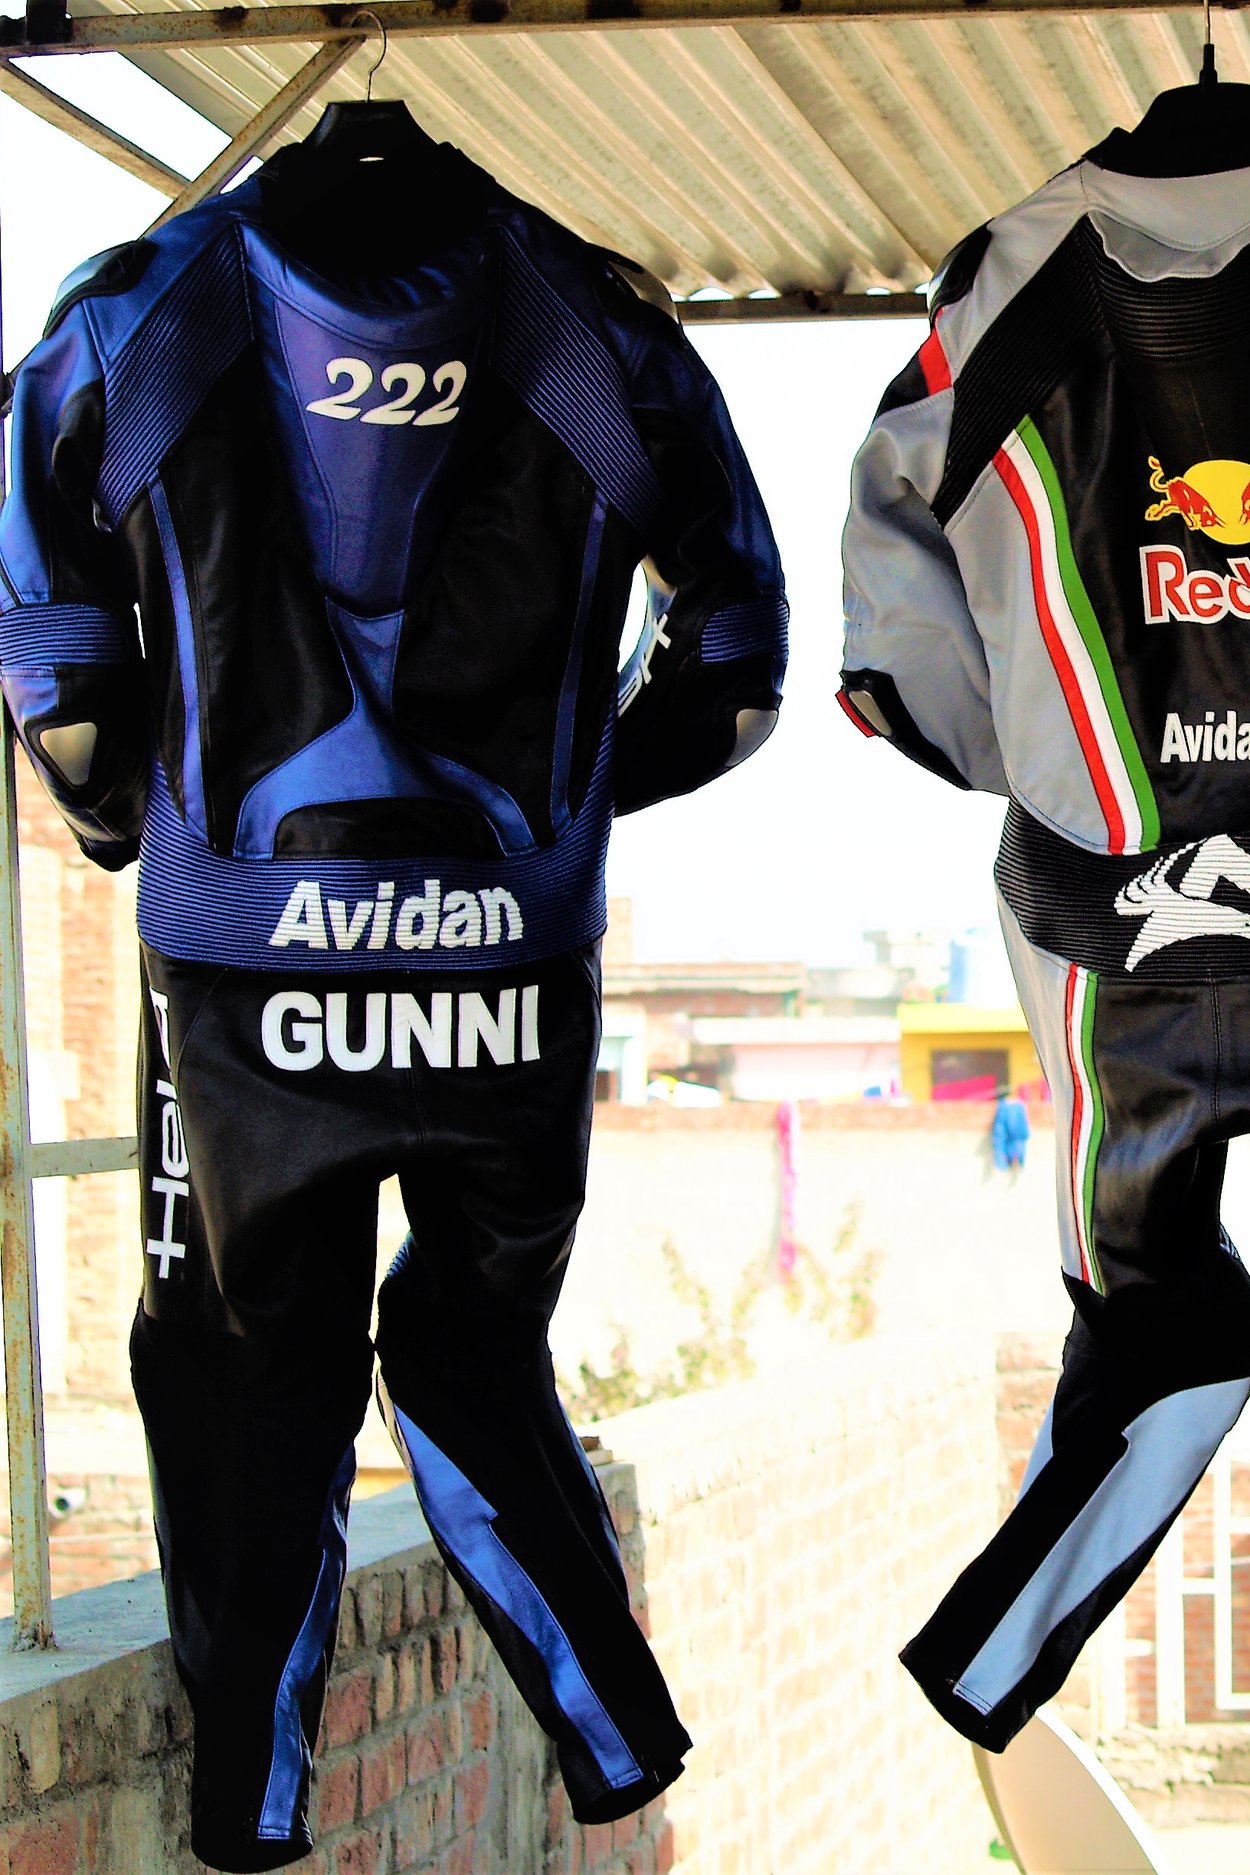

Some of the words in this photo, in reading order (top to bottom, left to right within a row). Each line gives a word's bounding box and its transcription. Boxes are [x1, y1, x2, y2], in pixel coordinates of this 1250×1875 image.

[306, 358, 467, 426] 222
[268, 879, 524, 950] Avidan
[262, 985, 541, 1072] GUNNI
